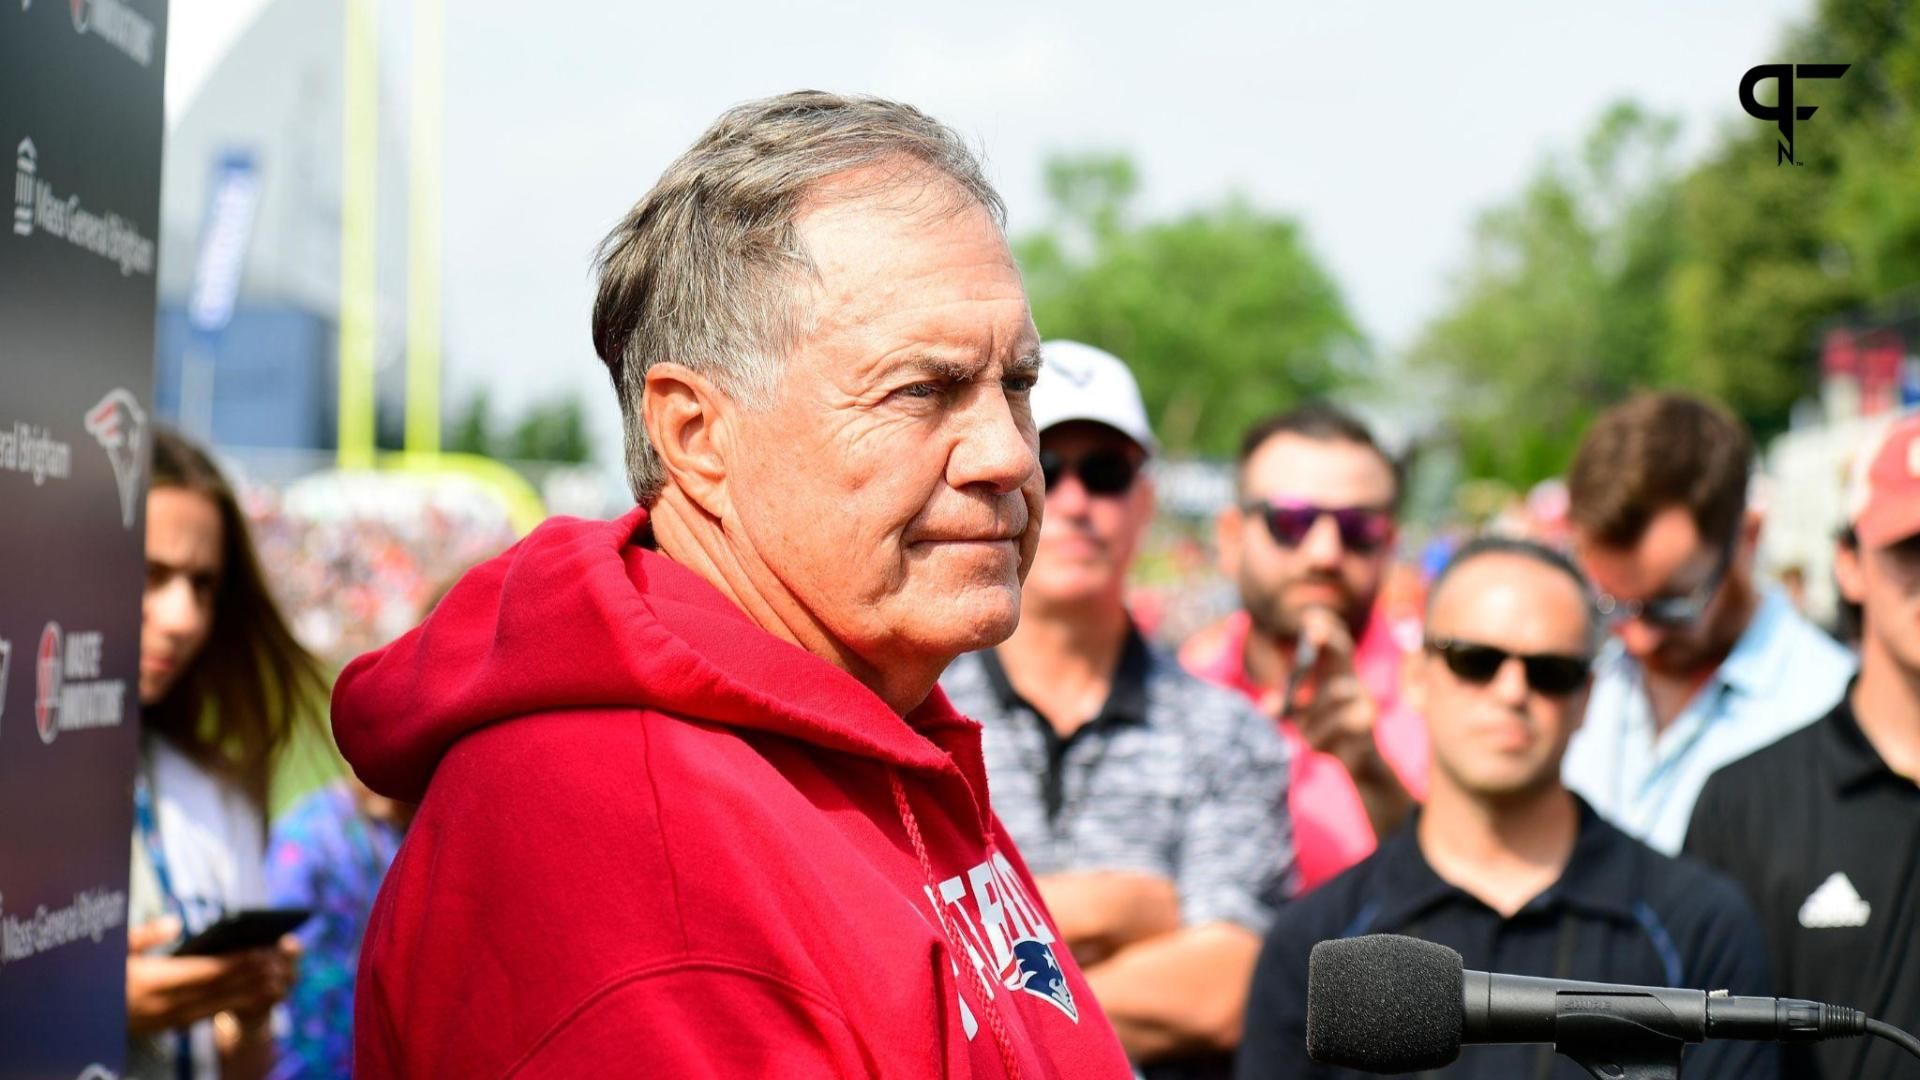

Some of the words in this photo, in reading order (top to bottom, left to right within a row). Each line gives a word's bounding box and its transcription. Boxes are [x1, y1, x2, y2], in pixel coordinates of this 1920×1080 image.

[35, 178, 66, 238] Mass
[65, 194, 108, 258] General
[19, 423, 71, 486] Brigham
[2, 914, 34, 962] Mass
[33, 904, 79, 953] General
